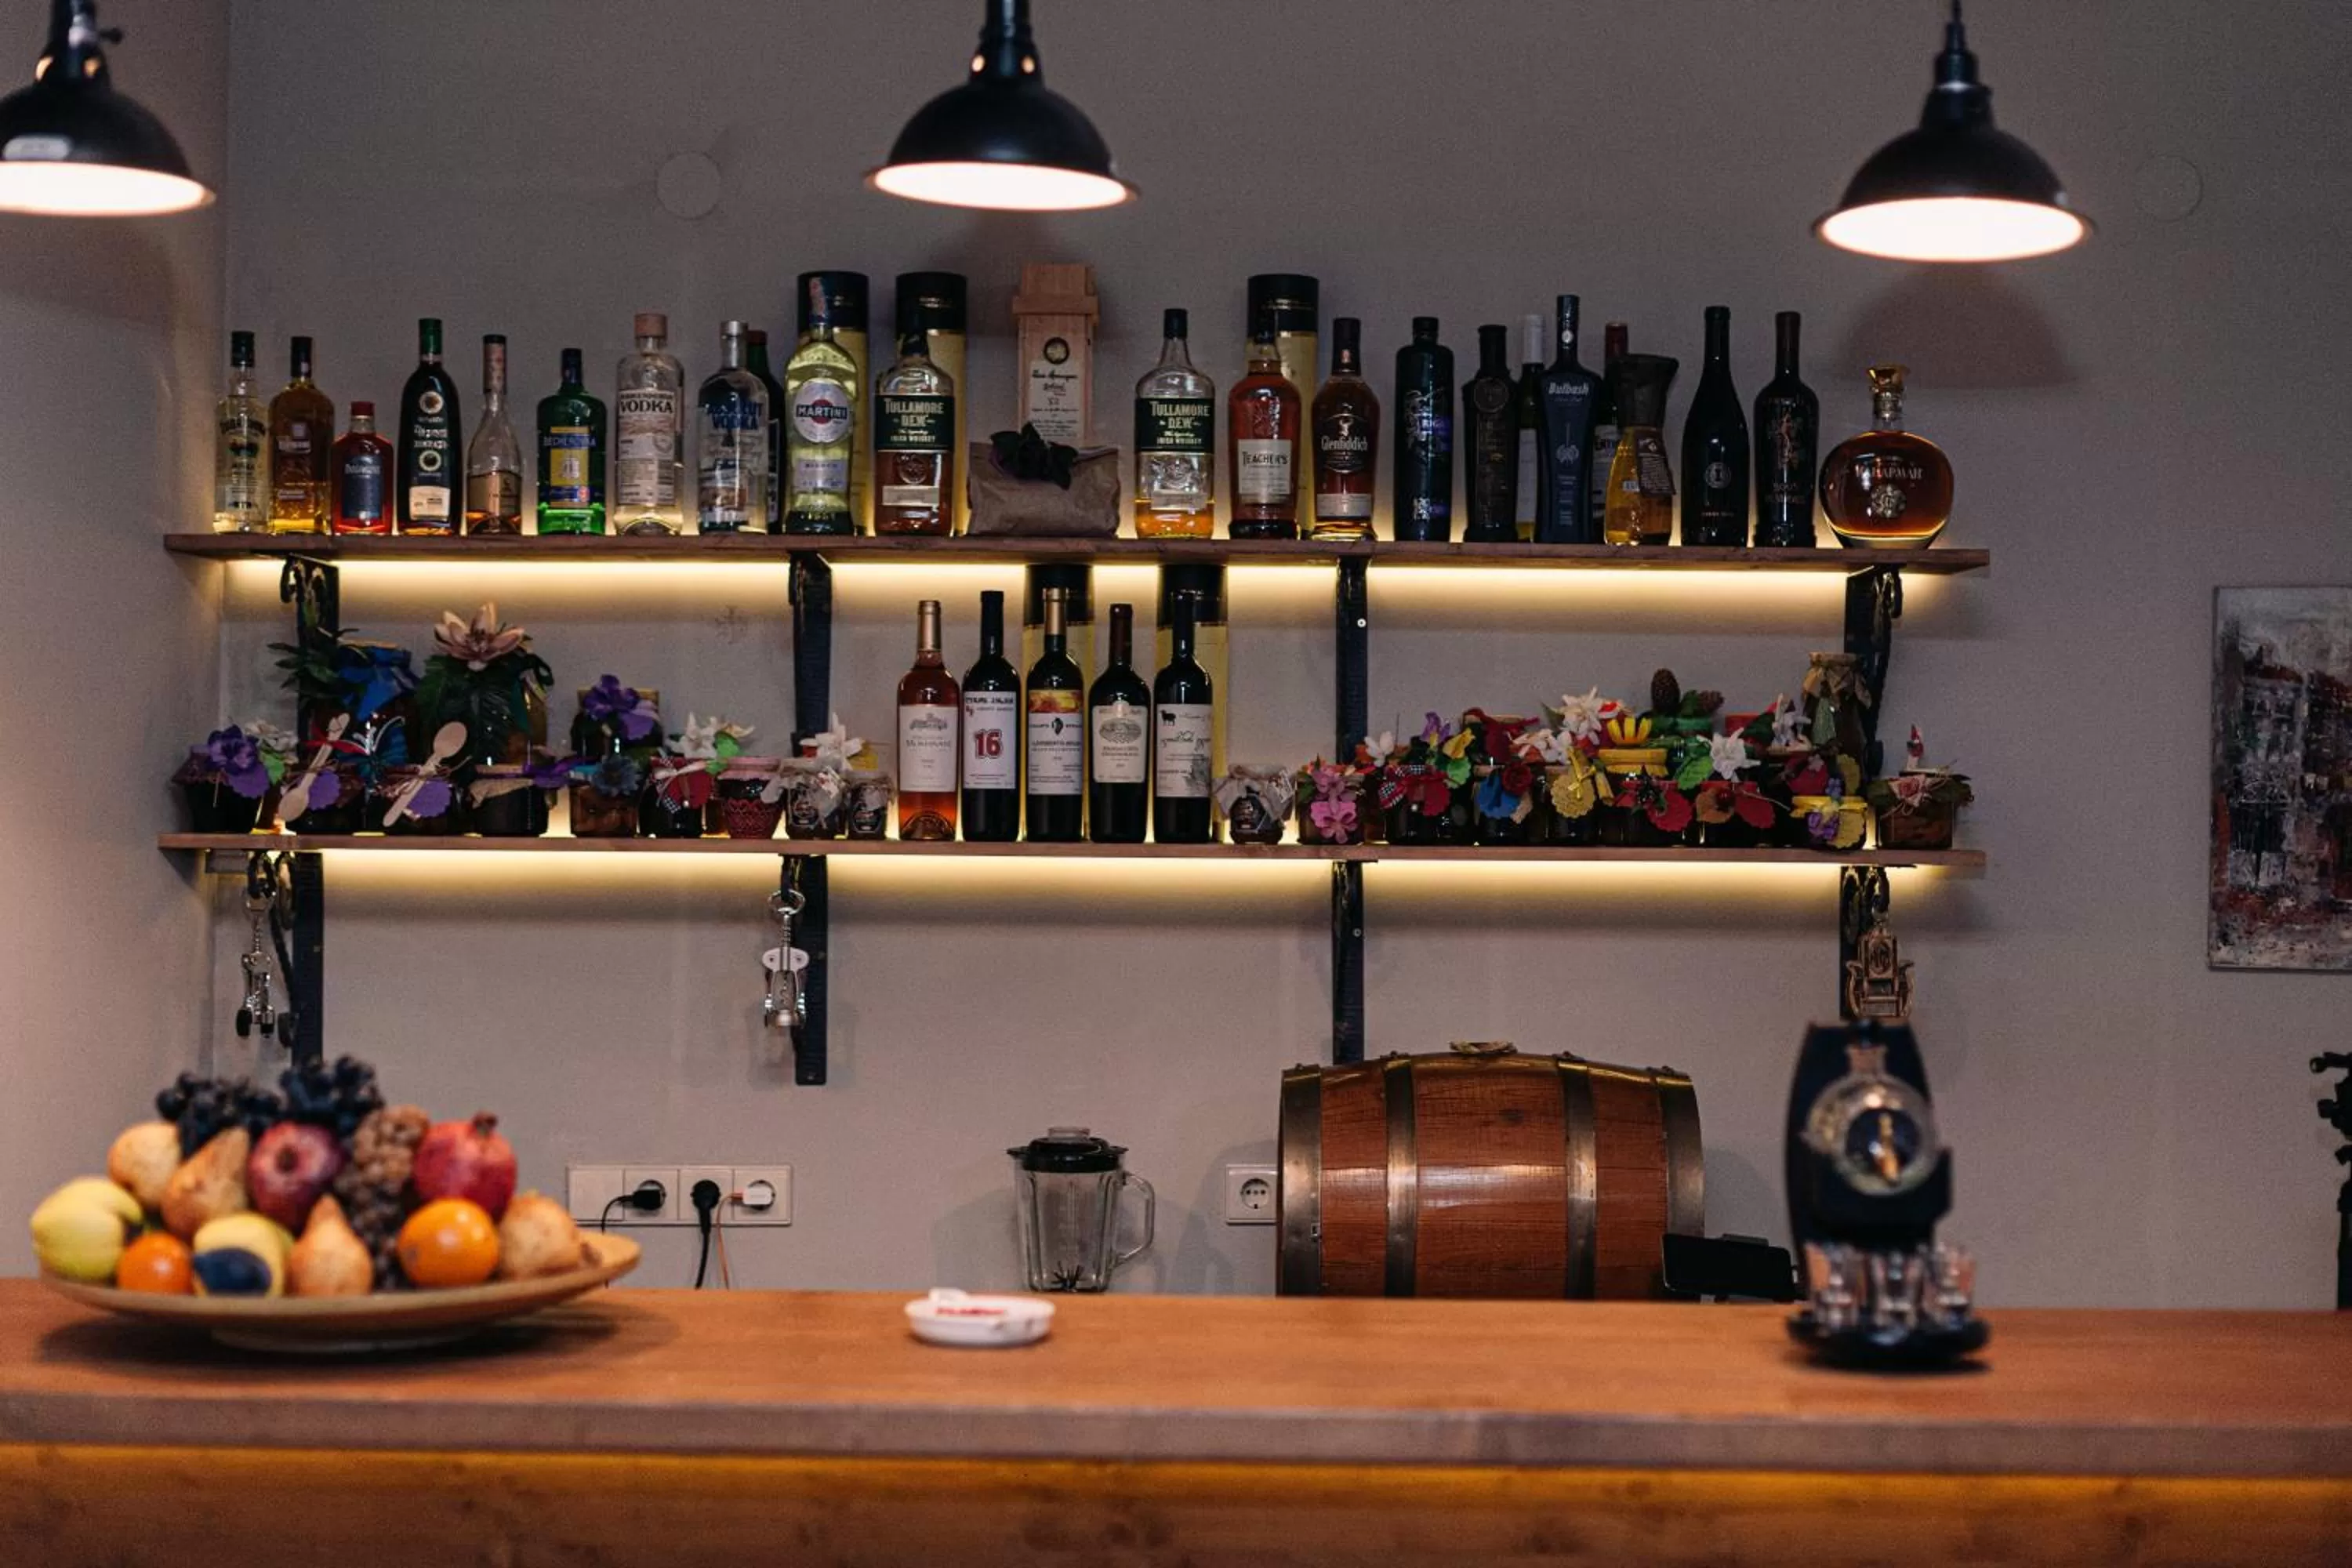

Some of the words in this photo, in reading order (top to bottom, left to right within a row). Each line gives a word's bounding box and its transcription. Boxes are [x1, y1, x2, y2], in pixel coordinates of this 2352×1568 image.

[1548, 382, 1589, 395] Bulbash
[620, 399, 673, 414] VODKA
[797, 406, 847, 418] MARTINI
[884, 397, 945, 414] TULLAMORE
[1149, 401, 1210, 416] TULLAMORE
[1321, 435, 1368, 452] Glenfiddich
[975, 729, 1004, 759] 16
